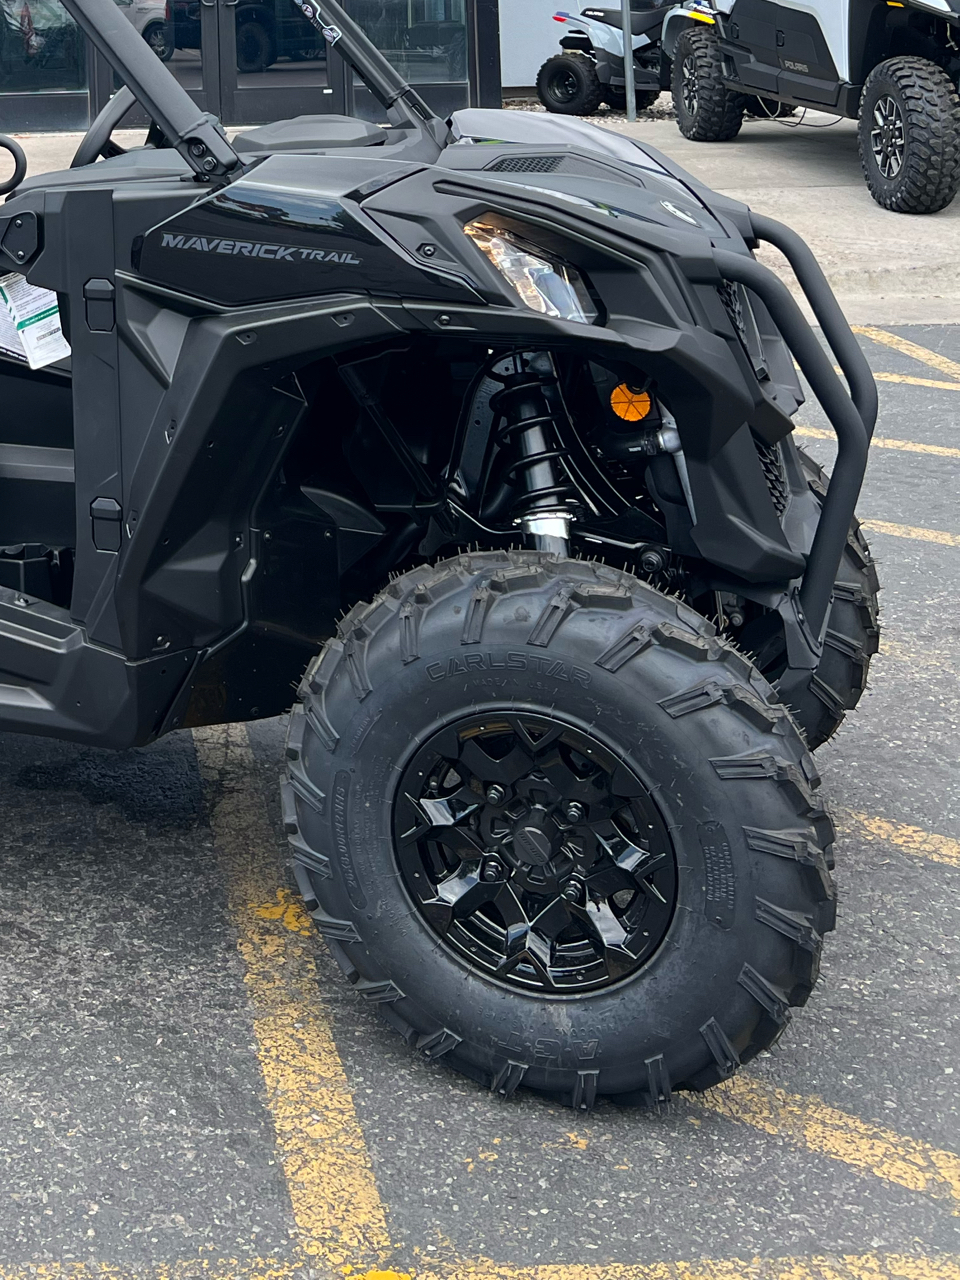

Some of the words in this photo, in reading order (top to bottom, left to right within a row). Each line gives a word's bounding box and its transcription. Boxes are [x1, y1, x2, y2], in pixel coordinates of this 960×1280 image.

[784, 60, 809, 72] POLARIS
[161, 233, 298, 261] MAVERICK
[298, 248, 362, 265] TRAIL
[424, 651, 593, 689] CARLSTAR
